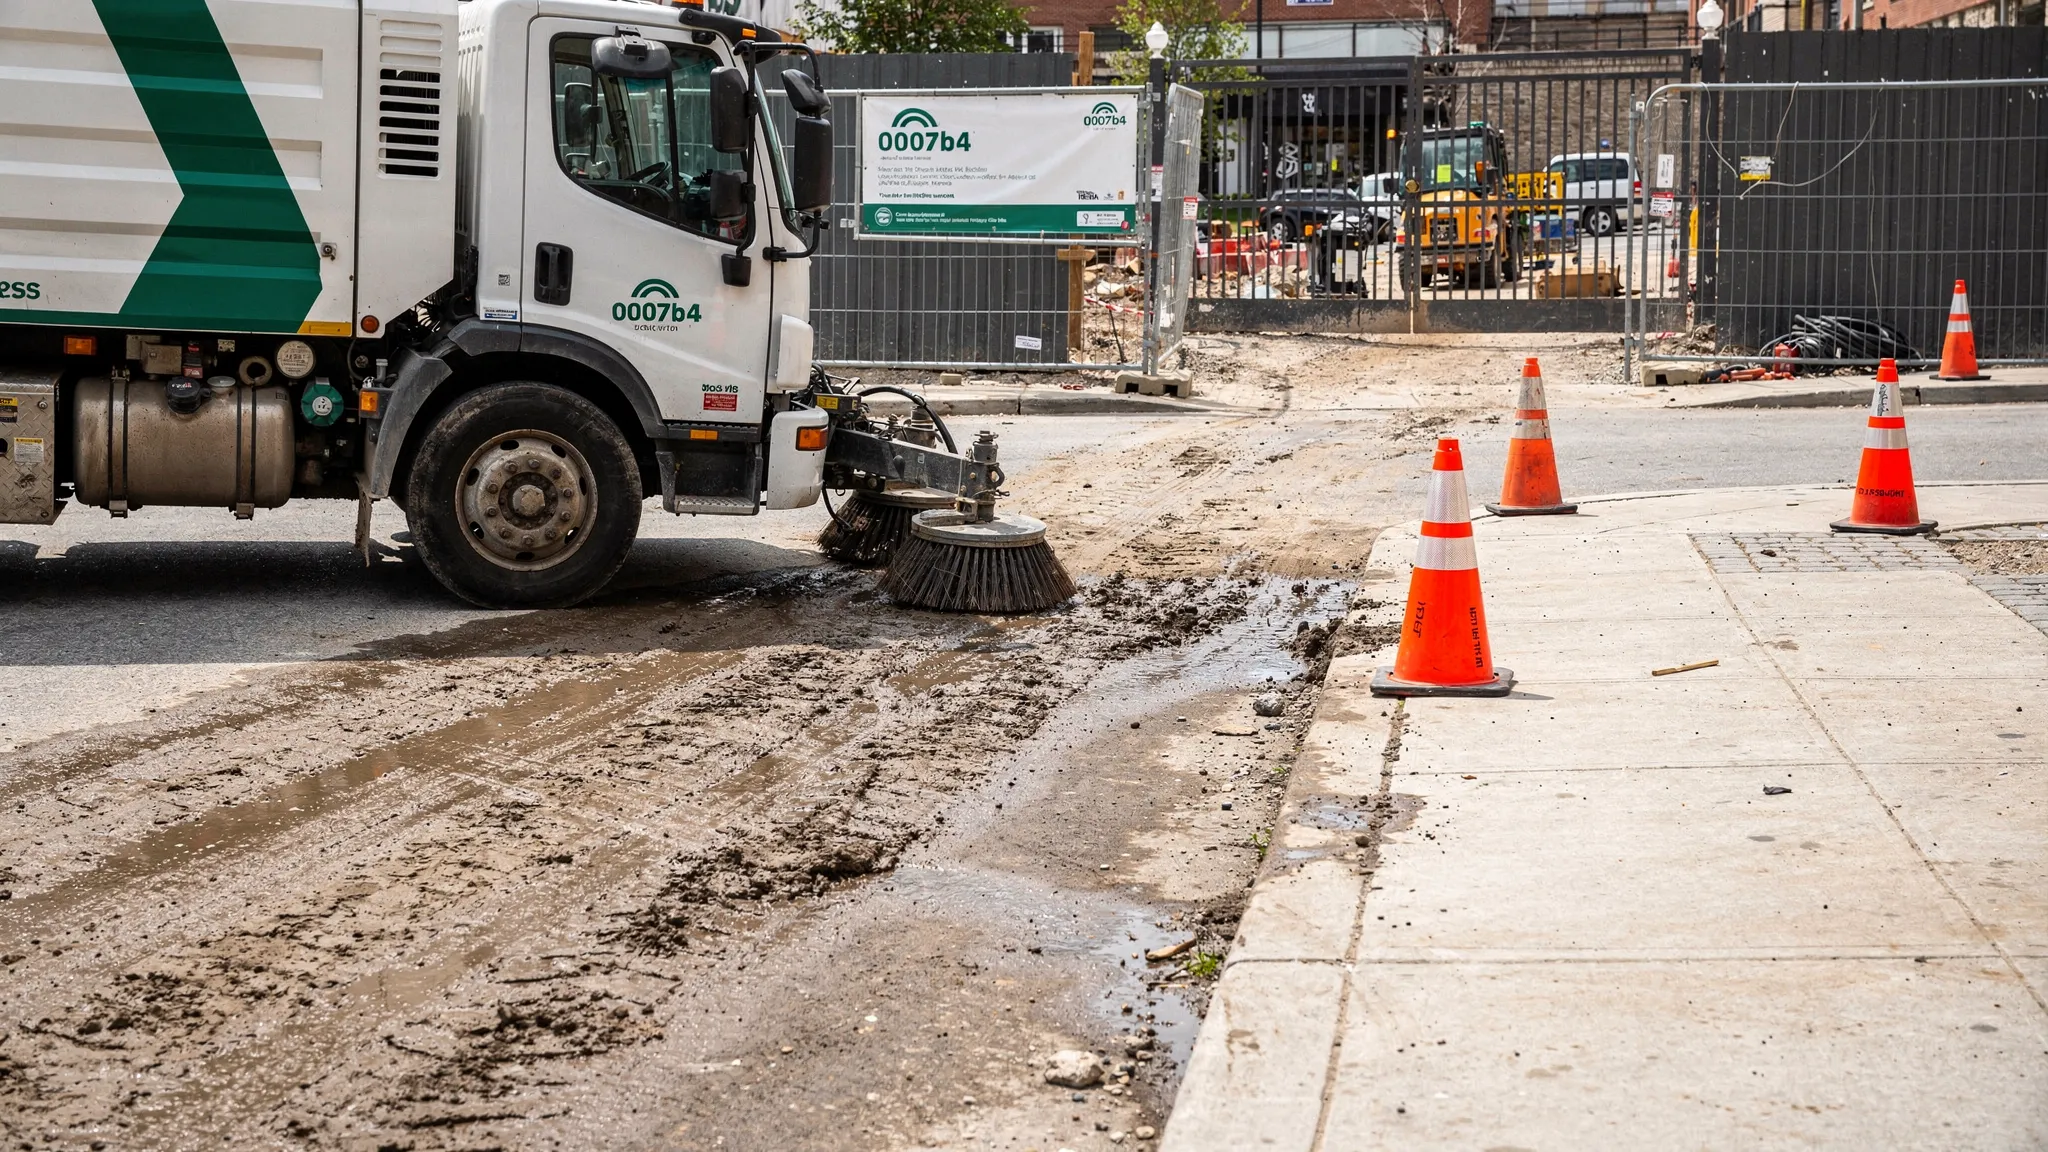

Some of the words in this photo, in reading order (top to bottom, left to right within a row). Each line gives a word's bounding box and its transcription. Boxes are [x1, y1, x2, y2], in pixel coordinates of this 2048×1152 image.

[1083, 115, 1127, 126] 0007b4
[878, 131, 971, 151] 0007b4
[611, 302, 702, 322] 0007b4
